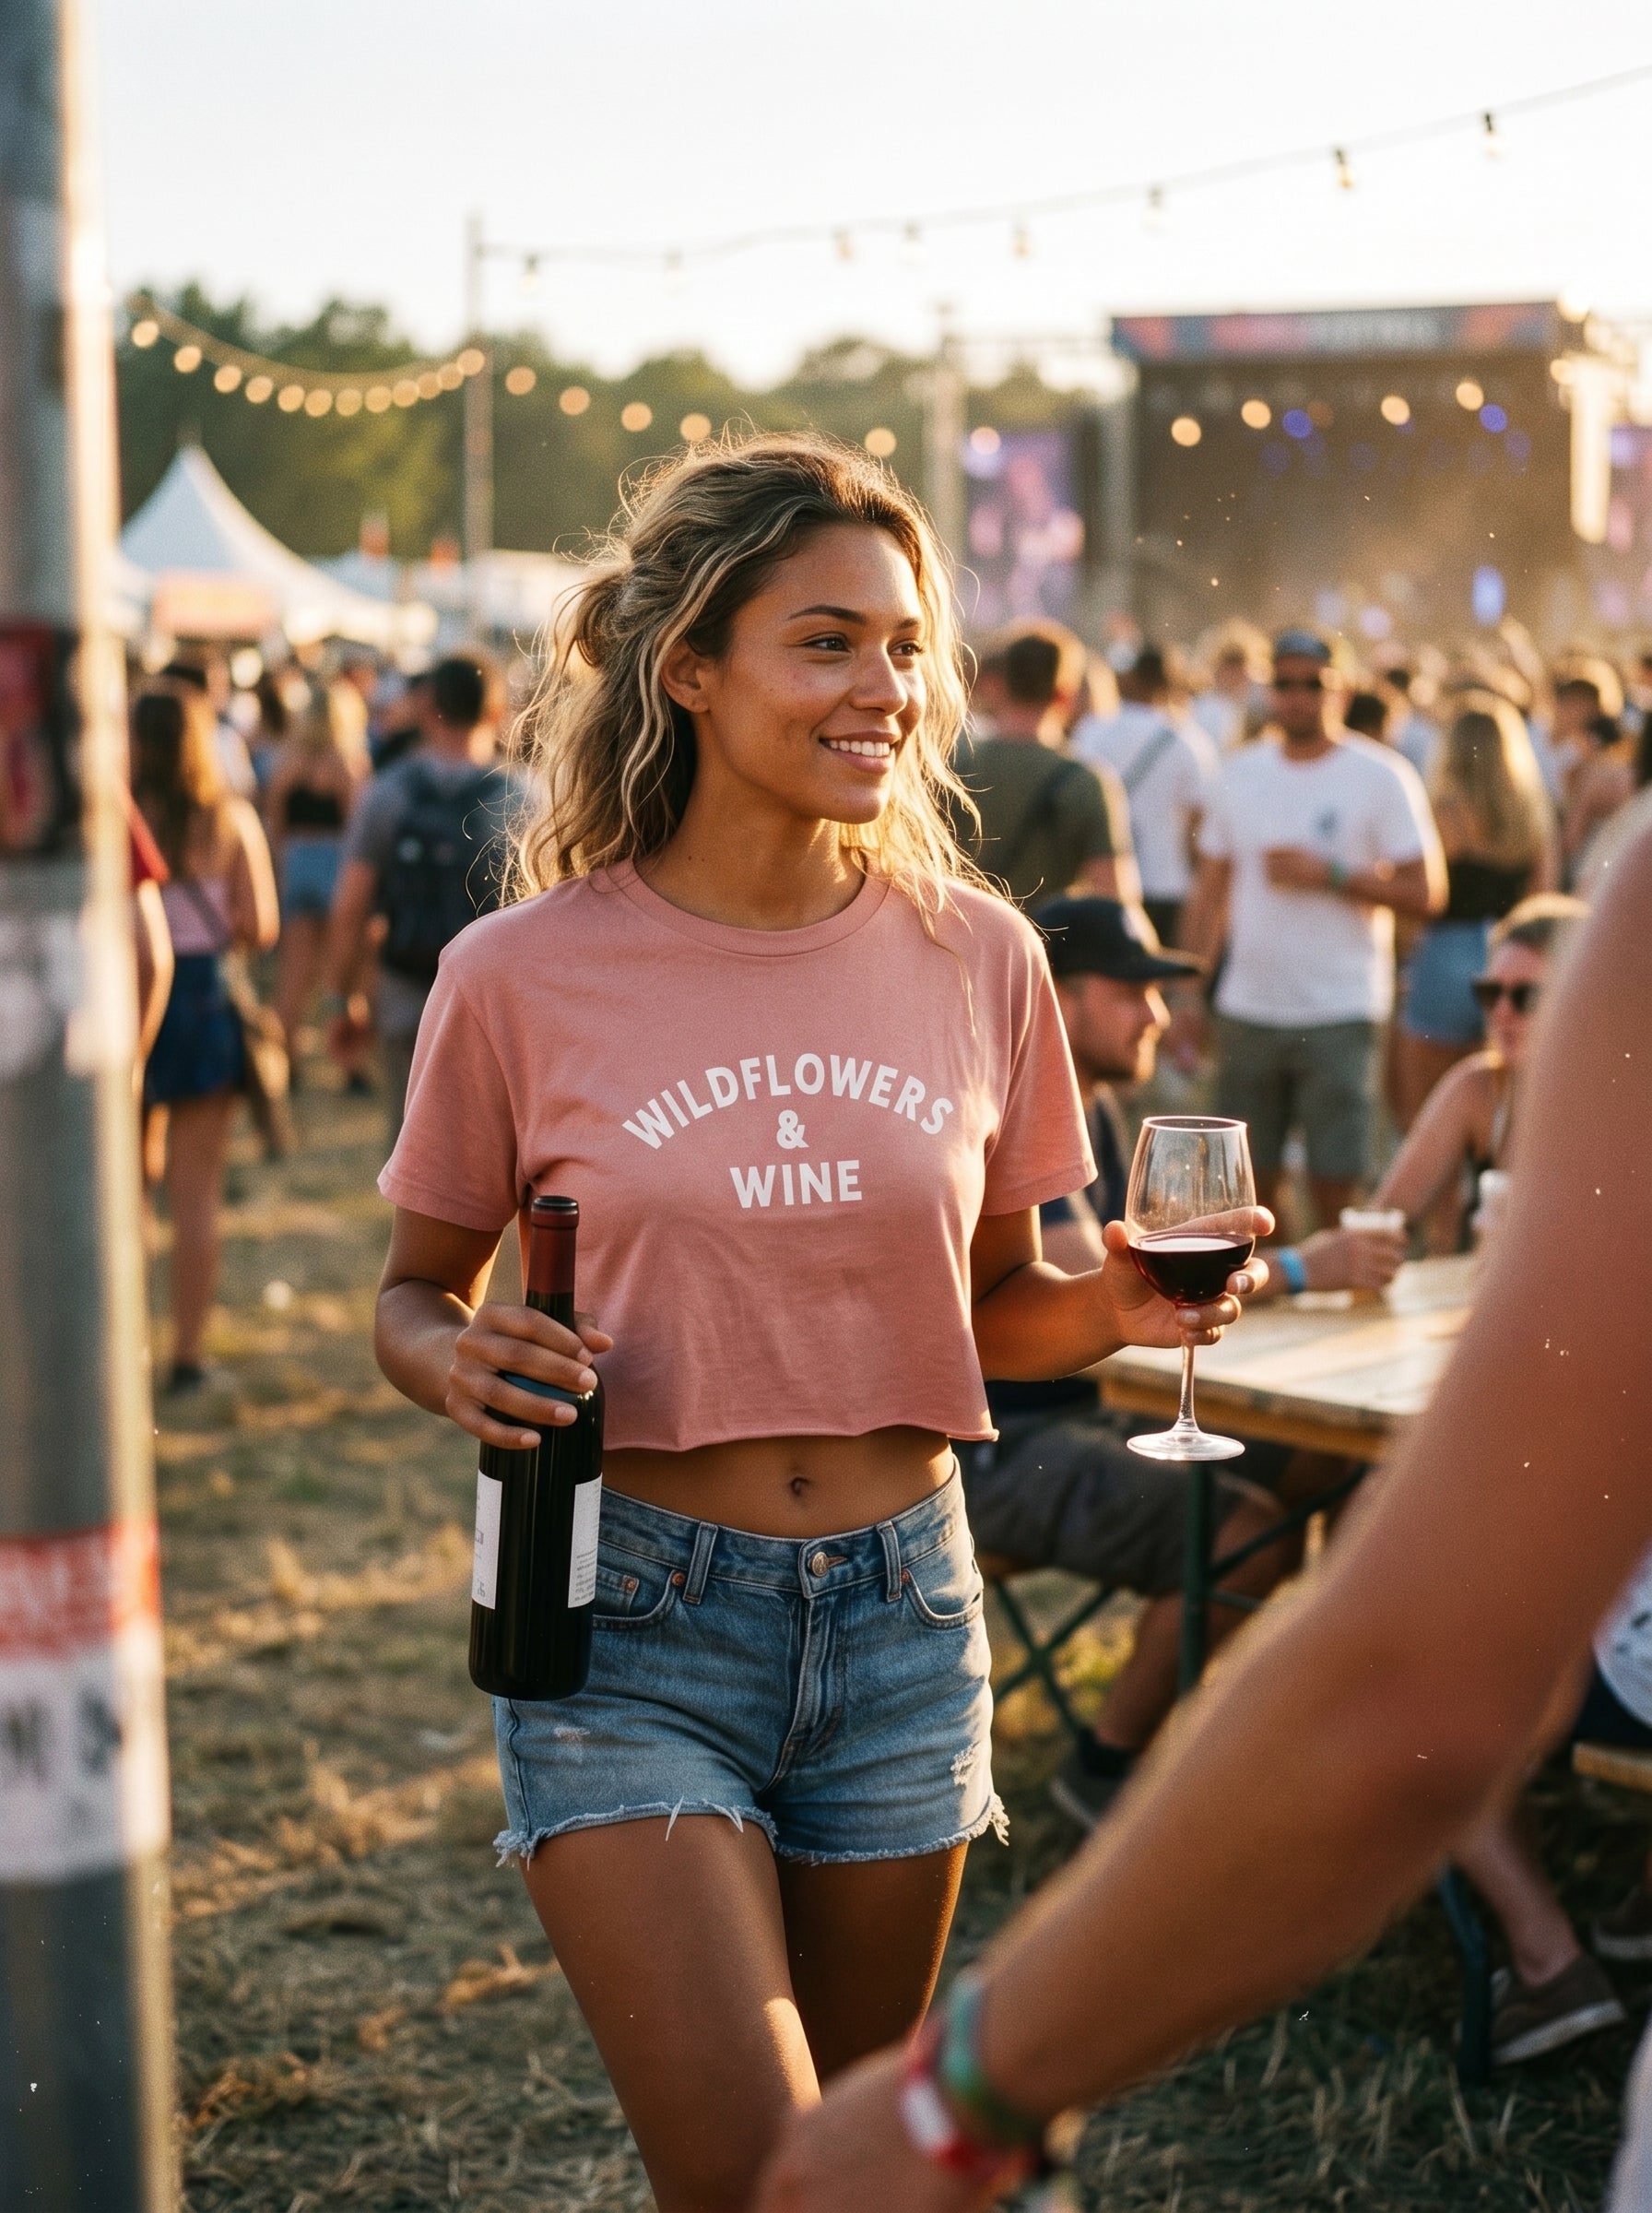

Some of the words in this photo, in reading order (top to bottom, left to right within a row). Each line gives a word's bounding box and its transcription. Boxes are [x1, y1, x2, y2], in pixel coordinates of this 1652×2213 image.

[622, 1053, 953, 1149] WILDFLOWERS
[776, 1109, 808, 1149] &
[729, 1159, 862, 1208] WINE
